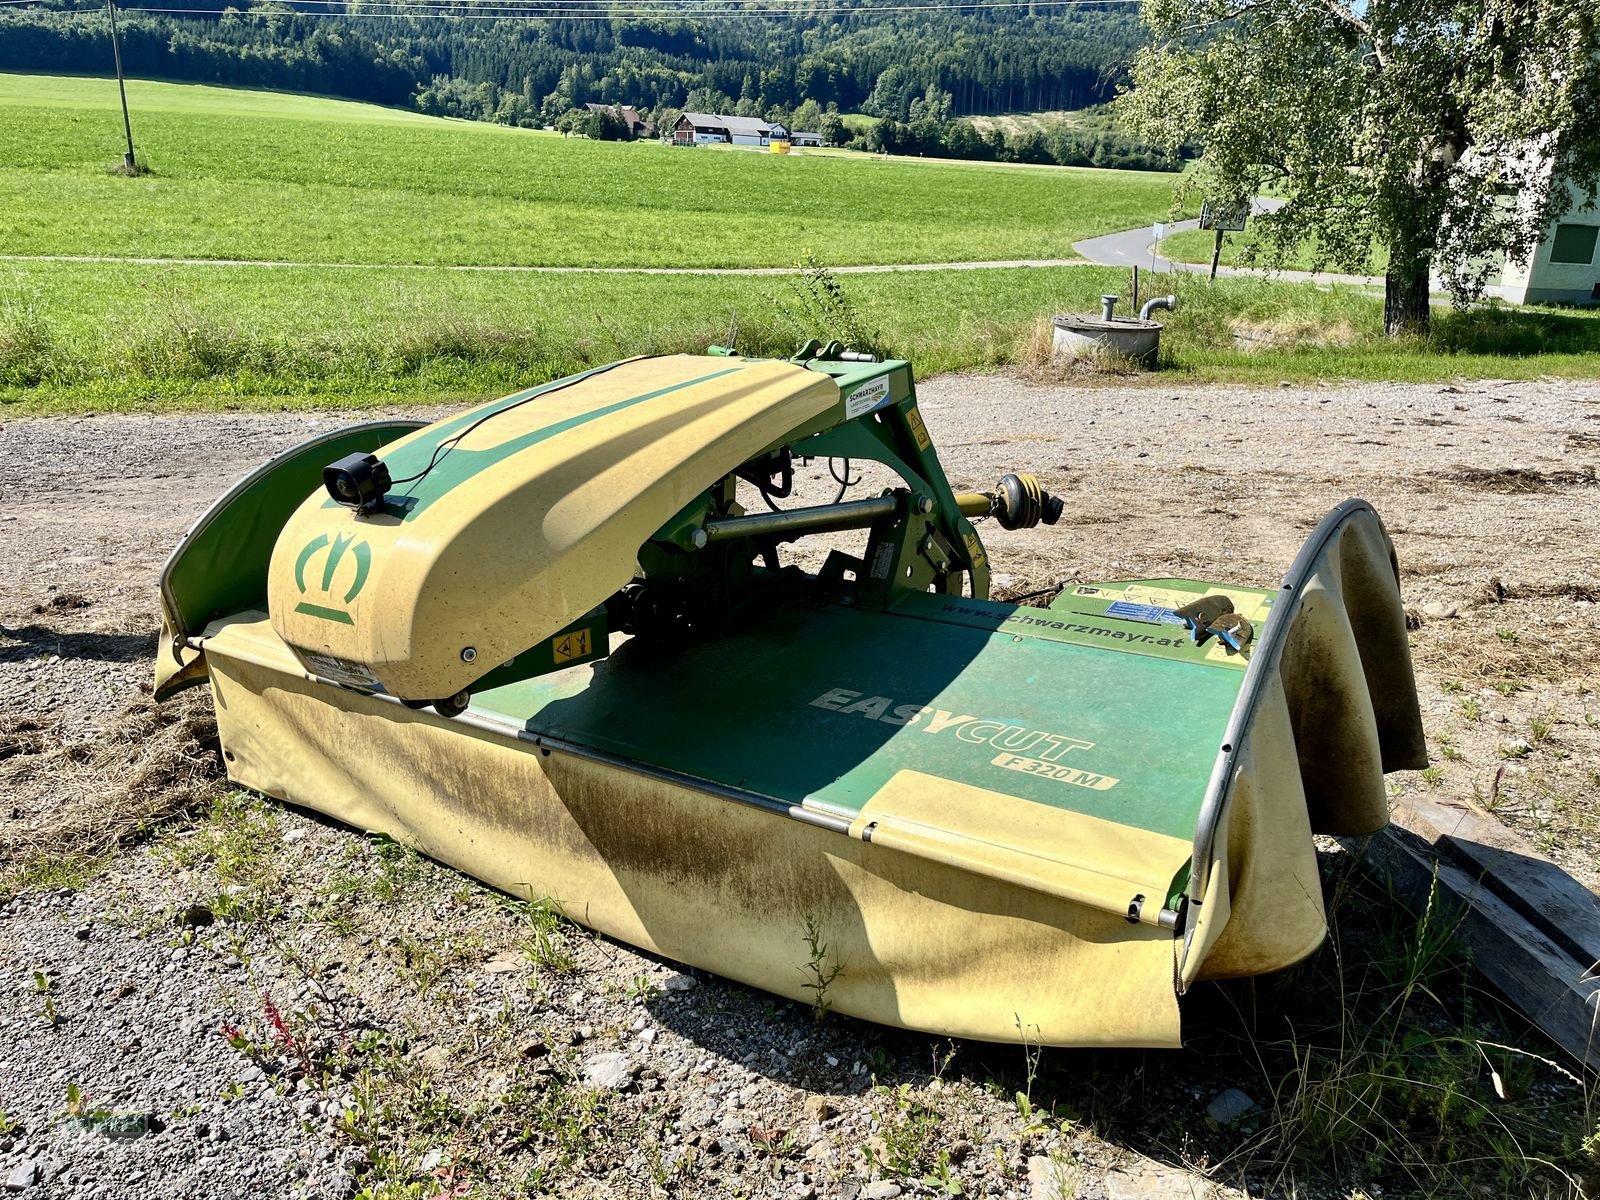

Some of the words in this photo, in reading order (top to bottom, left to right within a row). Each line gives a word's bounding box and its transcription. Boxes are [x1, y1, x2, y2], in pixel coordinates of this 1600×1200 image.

[850, 384, 883, 402] SCHWARZMAYR
[943, 603, 1184, 647] www.schwarzmayr.at
[1004, 757, 1022, 766] F
[1024, 761, 1071, 779] 320
[1074, 774, 1103, 787] M
